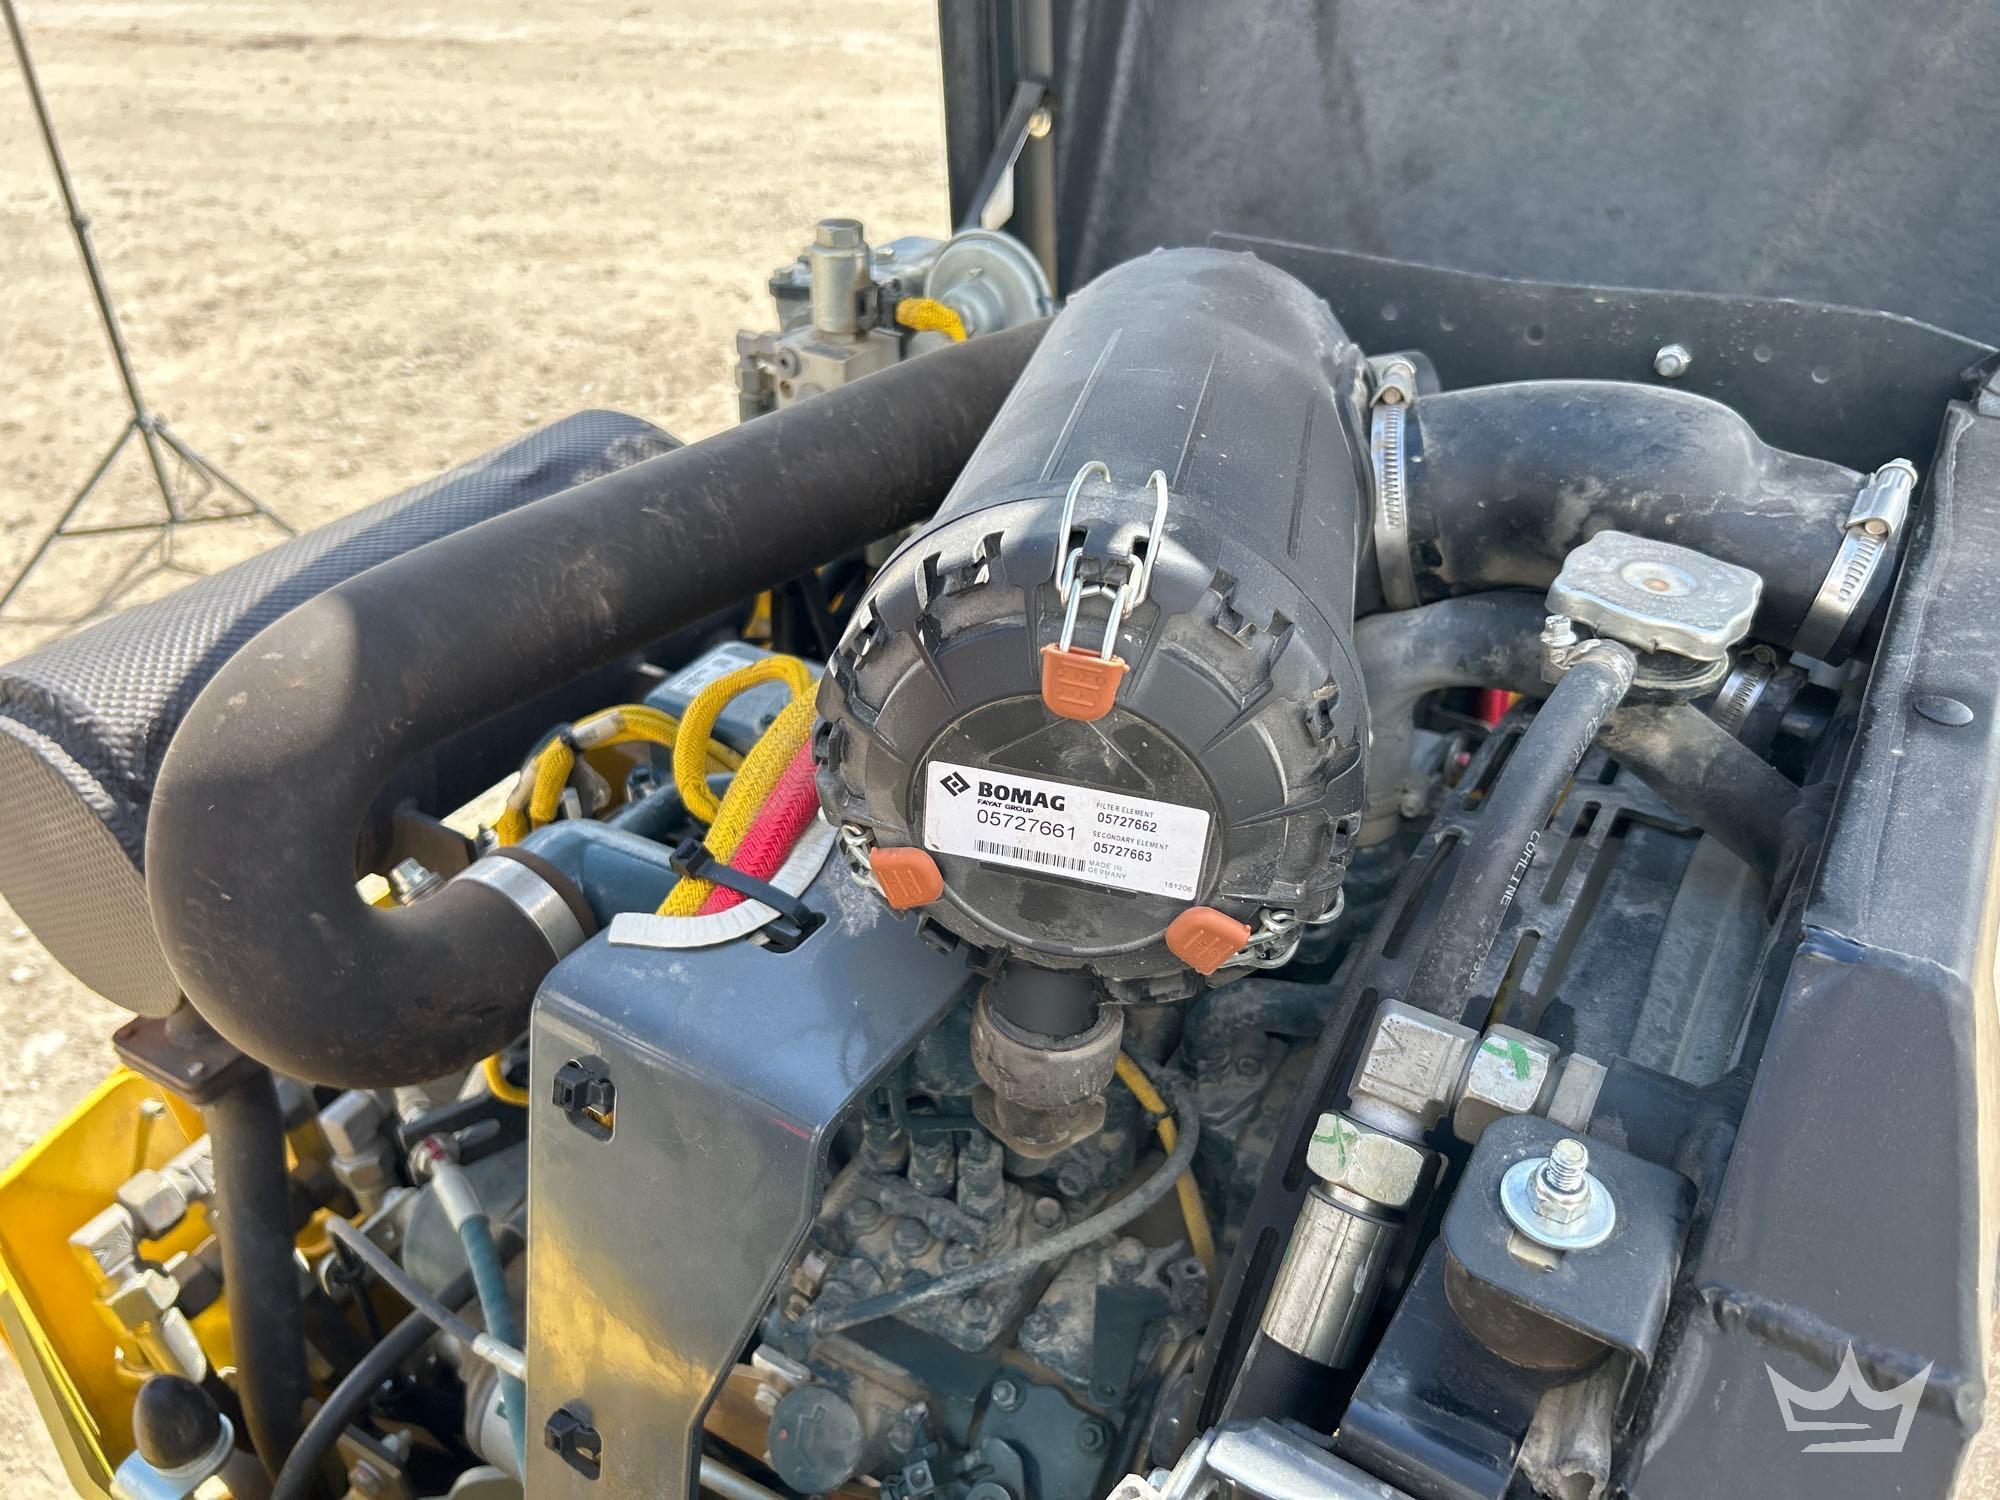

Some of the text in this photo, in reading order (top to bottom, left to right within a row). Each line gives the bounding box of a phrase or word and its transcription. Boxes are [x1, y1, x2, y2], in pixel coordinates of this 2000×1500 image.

[977, 799, 1034, 814] FAYAT GROUP
[978, 782, 1065, 811] BOMAG
[1096, 802, 1154, 818] FILTER ELEMENT
[977, 809, 1075, 841] 05727661
[1097, 812, 1157, 833] 05727662
[1092, 830, 1168, 851] SECONDARY ELEMENT
[1093, 842, 1153, 862] 05727663
[1087, 867, 1127, 879] GERMANY
[1088, 860, 1111, 870] MADE
[1500, 830, 1540, 906] COHLINE
